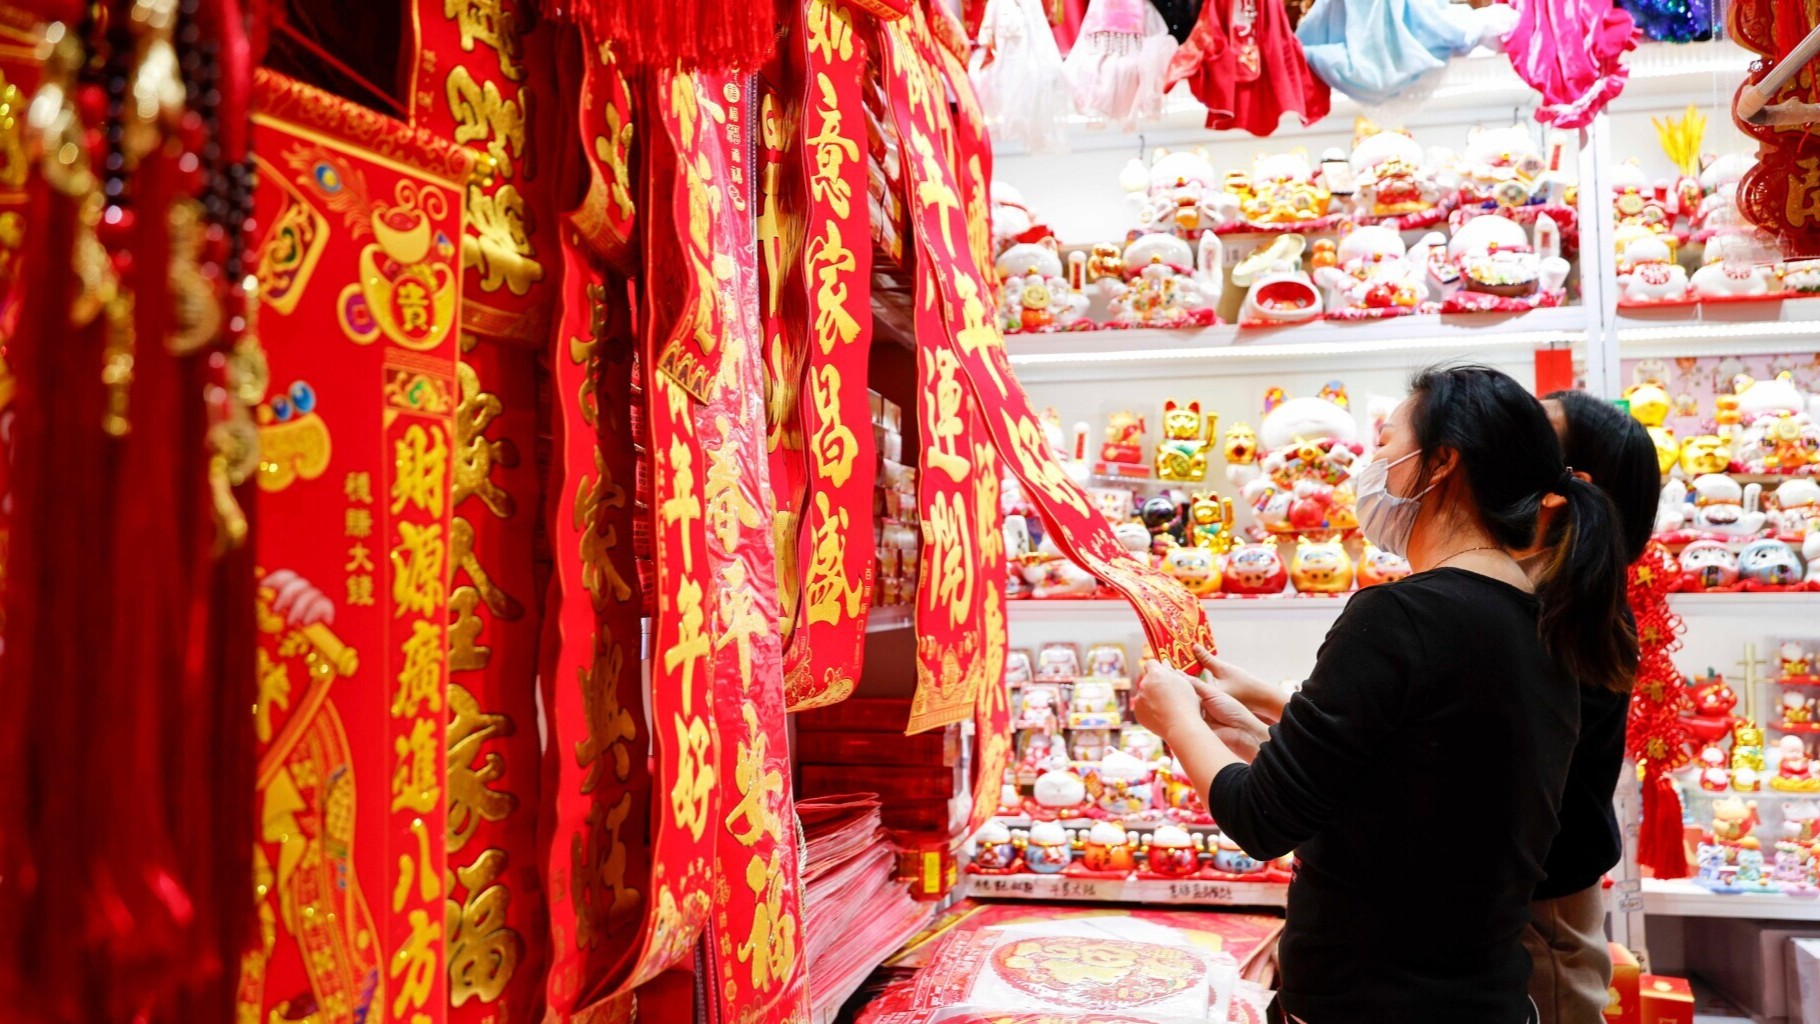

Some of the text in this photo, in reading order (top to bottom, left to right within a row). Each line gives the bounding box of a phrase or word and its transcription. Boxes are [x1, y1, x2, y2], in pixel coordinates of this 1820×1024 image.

[923, 266, 974, 632] 運開
[390, 424, 448, 1024] 財源廣進八方
